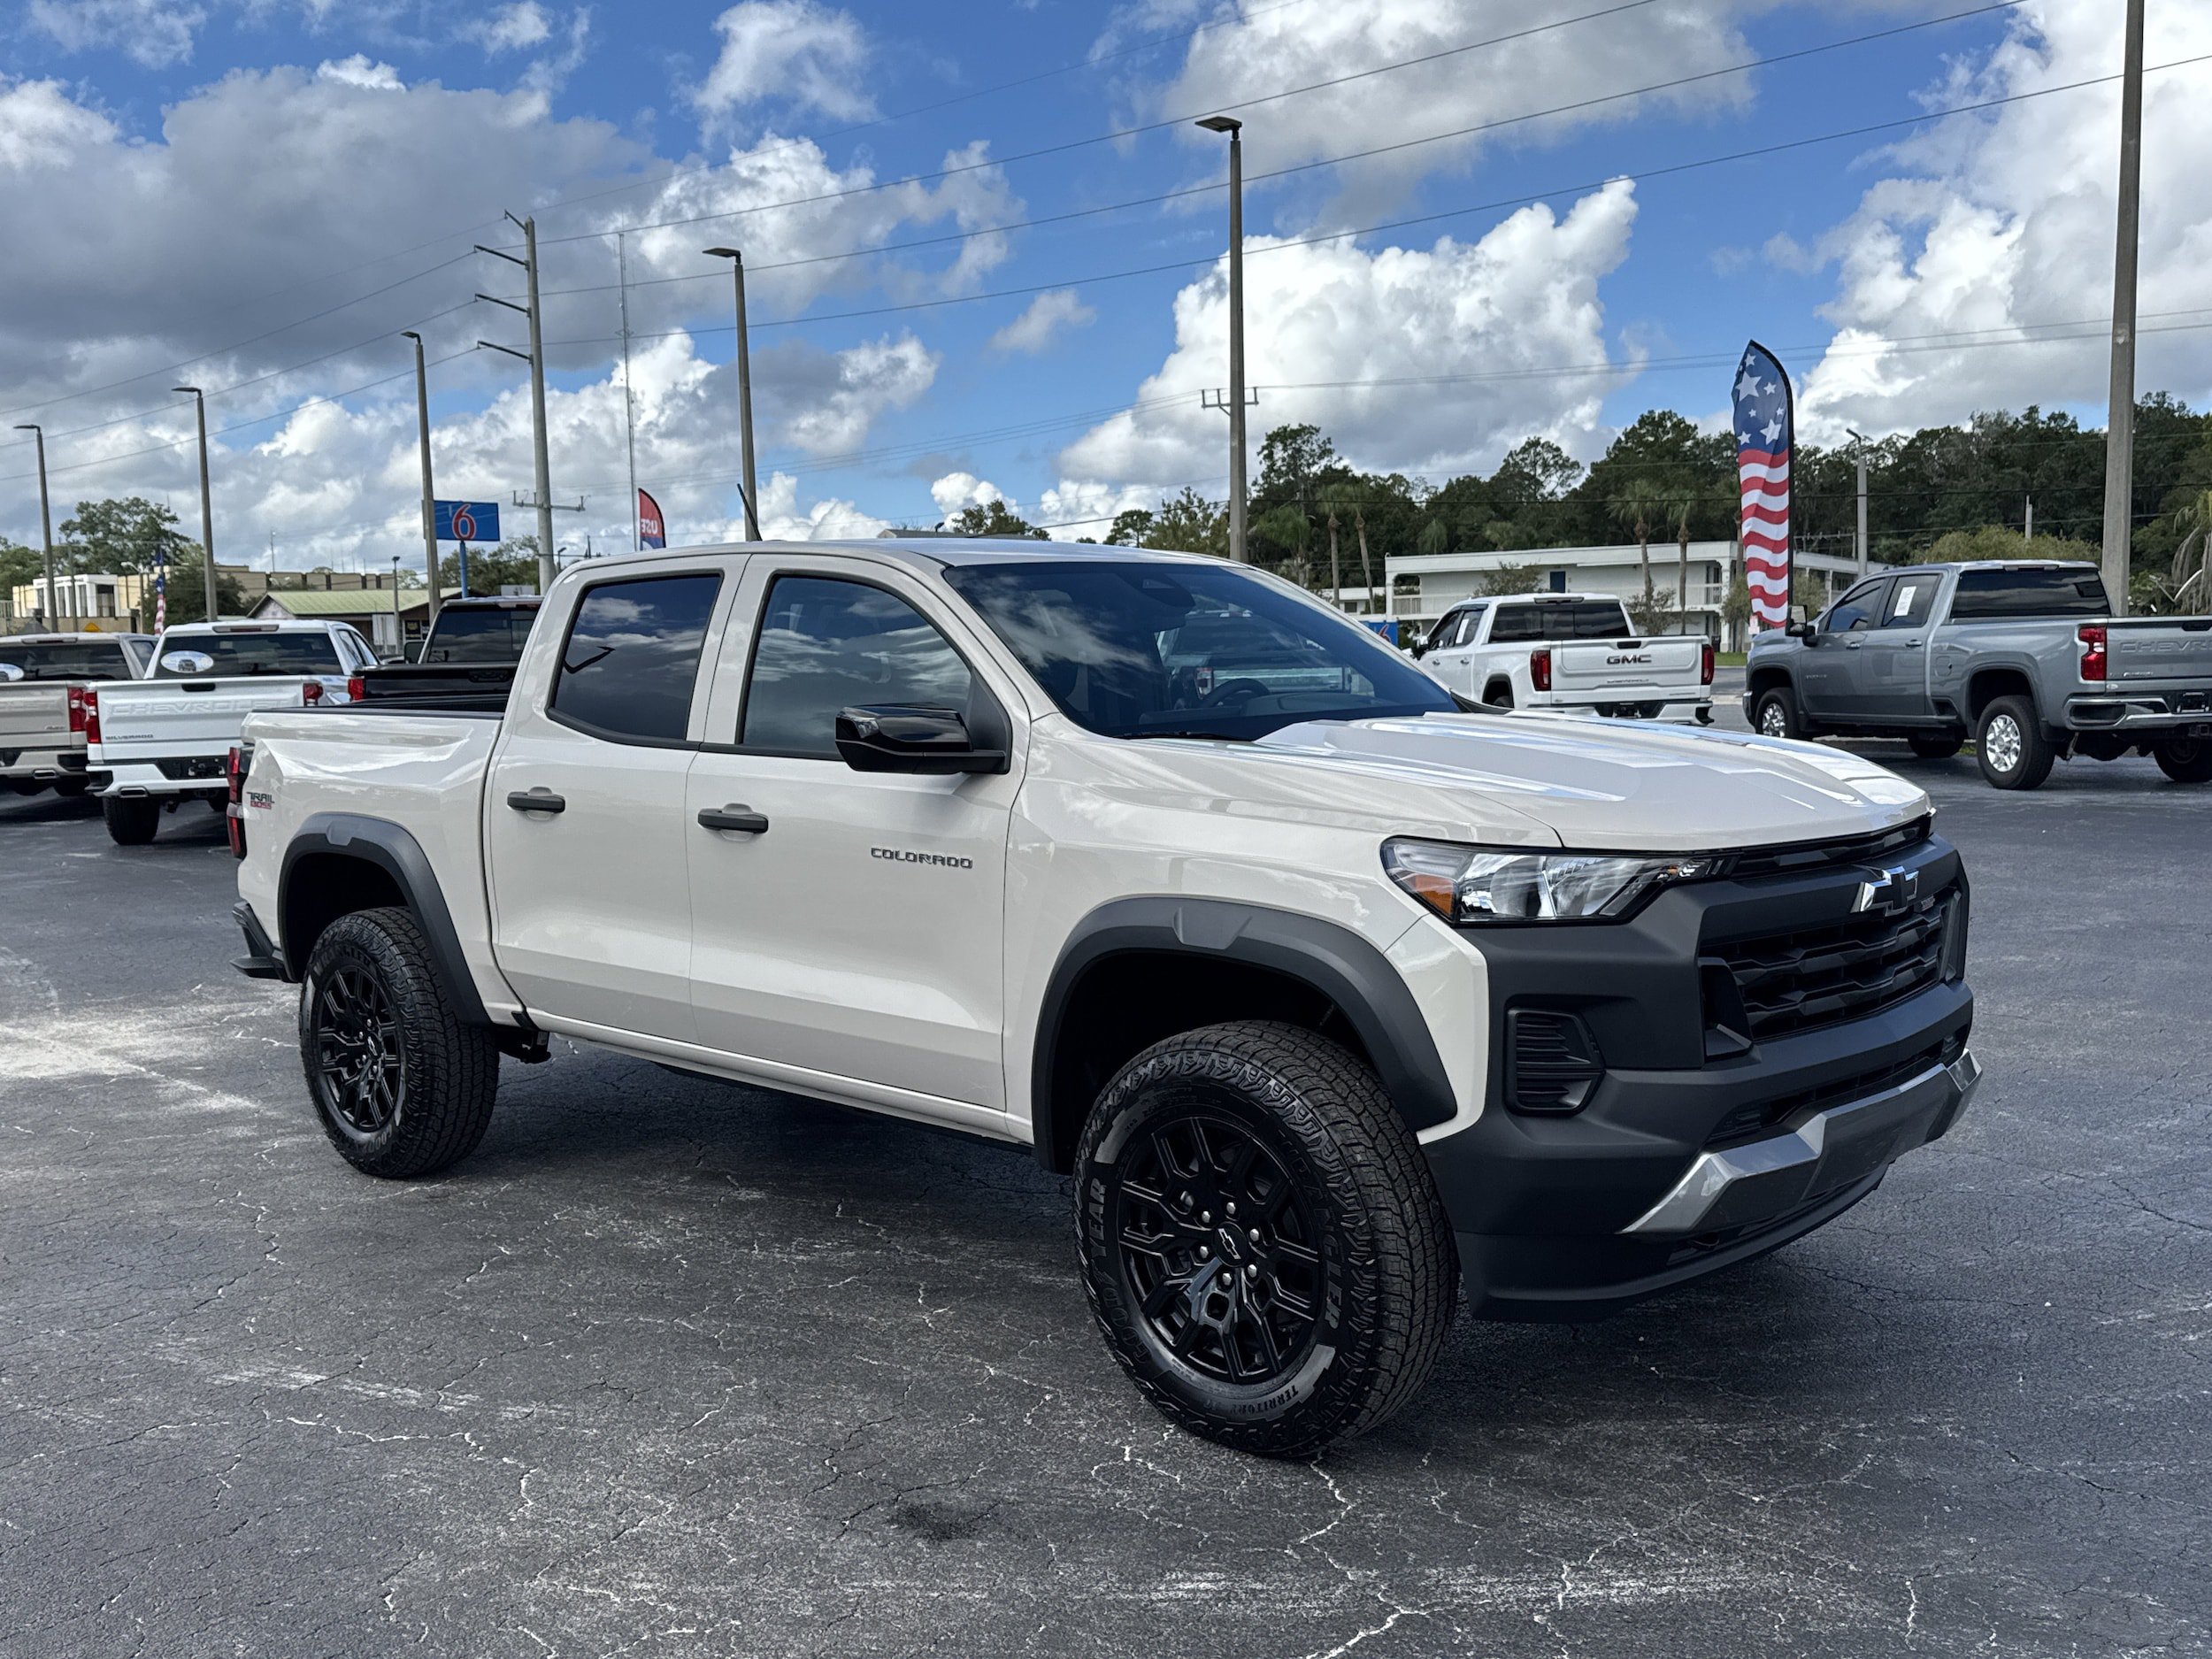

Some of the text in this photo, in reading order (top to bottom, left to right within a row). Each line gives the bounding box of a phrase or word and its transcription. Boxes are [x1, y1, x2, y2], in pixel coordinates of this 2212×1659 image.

[452, 503, 477, 540] 6
[1607, 654, 1652, 665] GMC
[246, 791, 275, 804] TRAIL
[250, 800, 273, 810] BOSS
[871, 847, 973, 869] COLORADO
